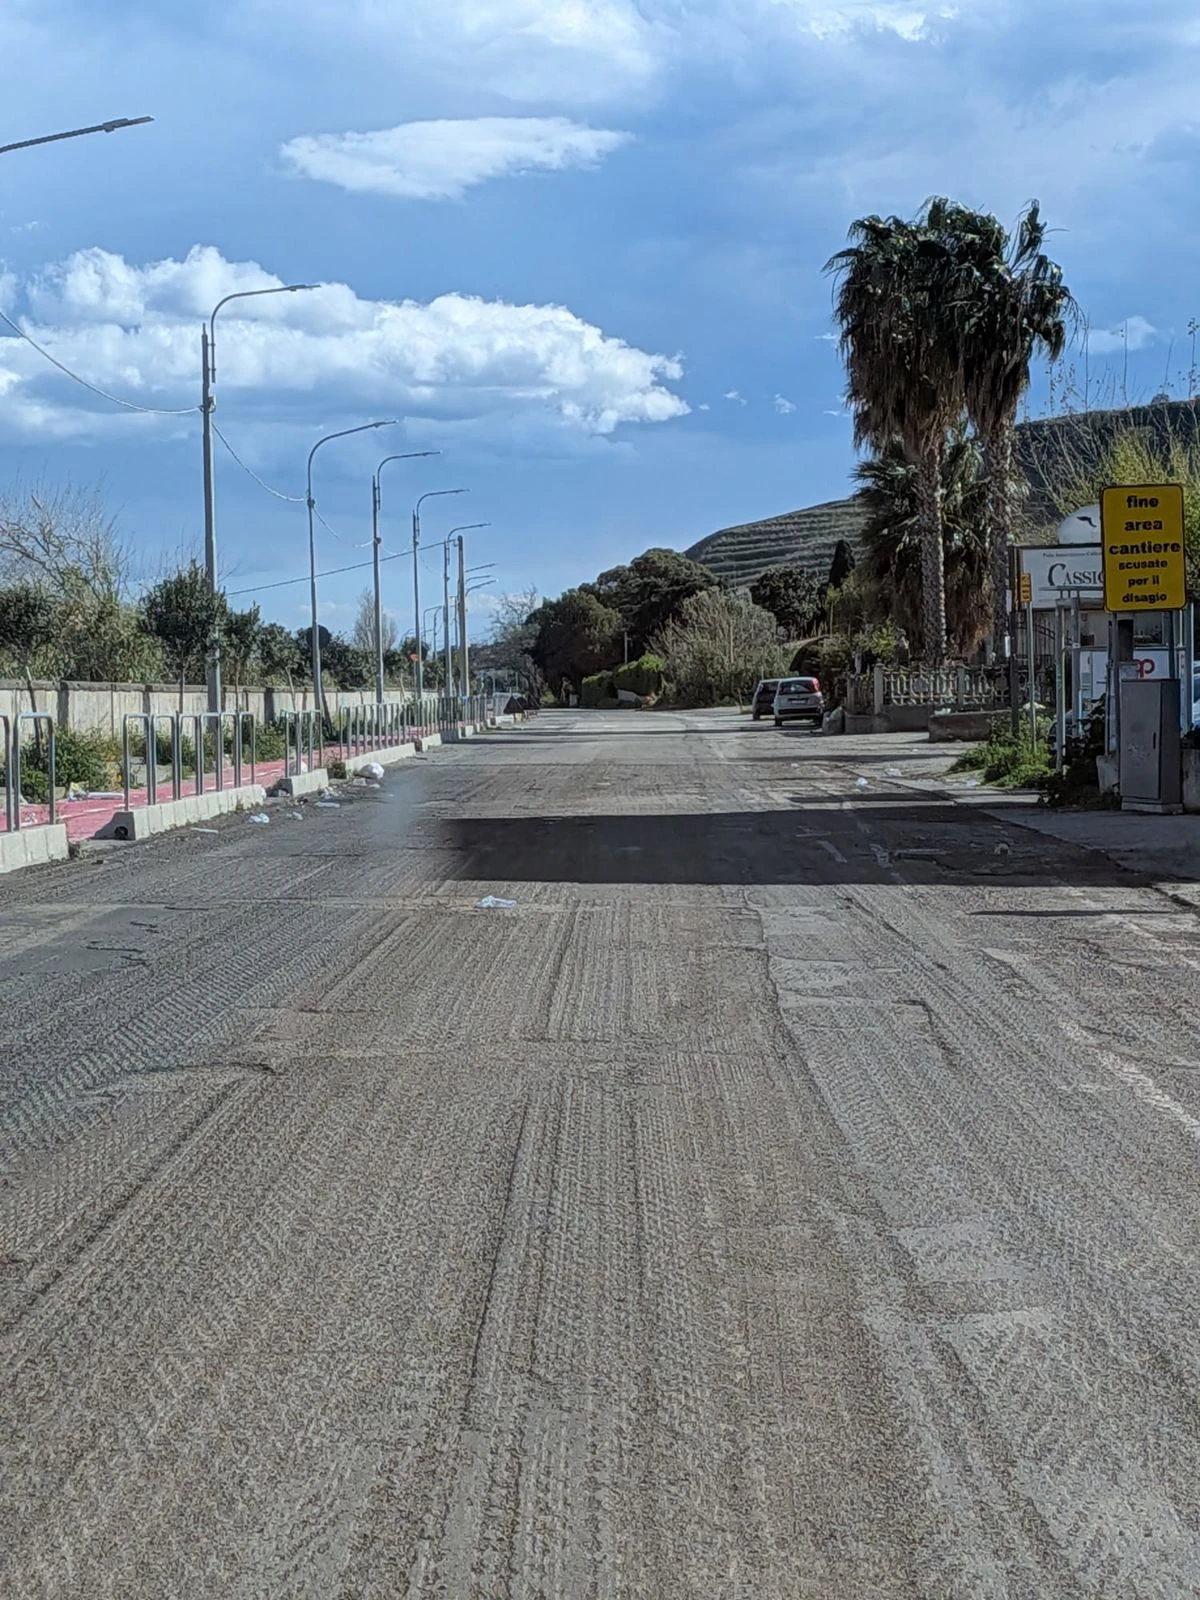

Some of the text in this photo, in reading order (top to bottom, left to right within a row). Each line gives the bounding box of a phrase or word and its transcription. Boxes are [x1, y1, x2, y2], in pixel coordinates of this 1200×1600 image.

[1126, 495, 1159, 508] fine
[1124, 520, 1163, 531] area
[1109, 541, 1181, 555] cantiere
[1119, 560, 1168, 570] scusate
[1128, 575, 1160, 588] per il
[1122, 593, 1167, 604] disagio
